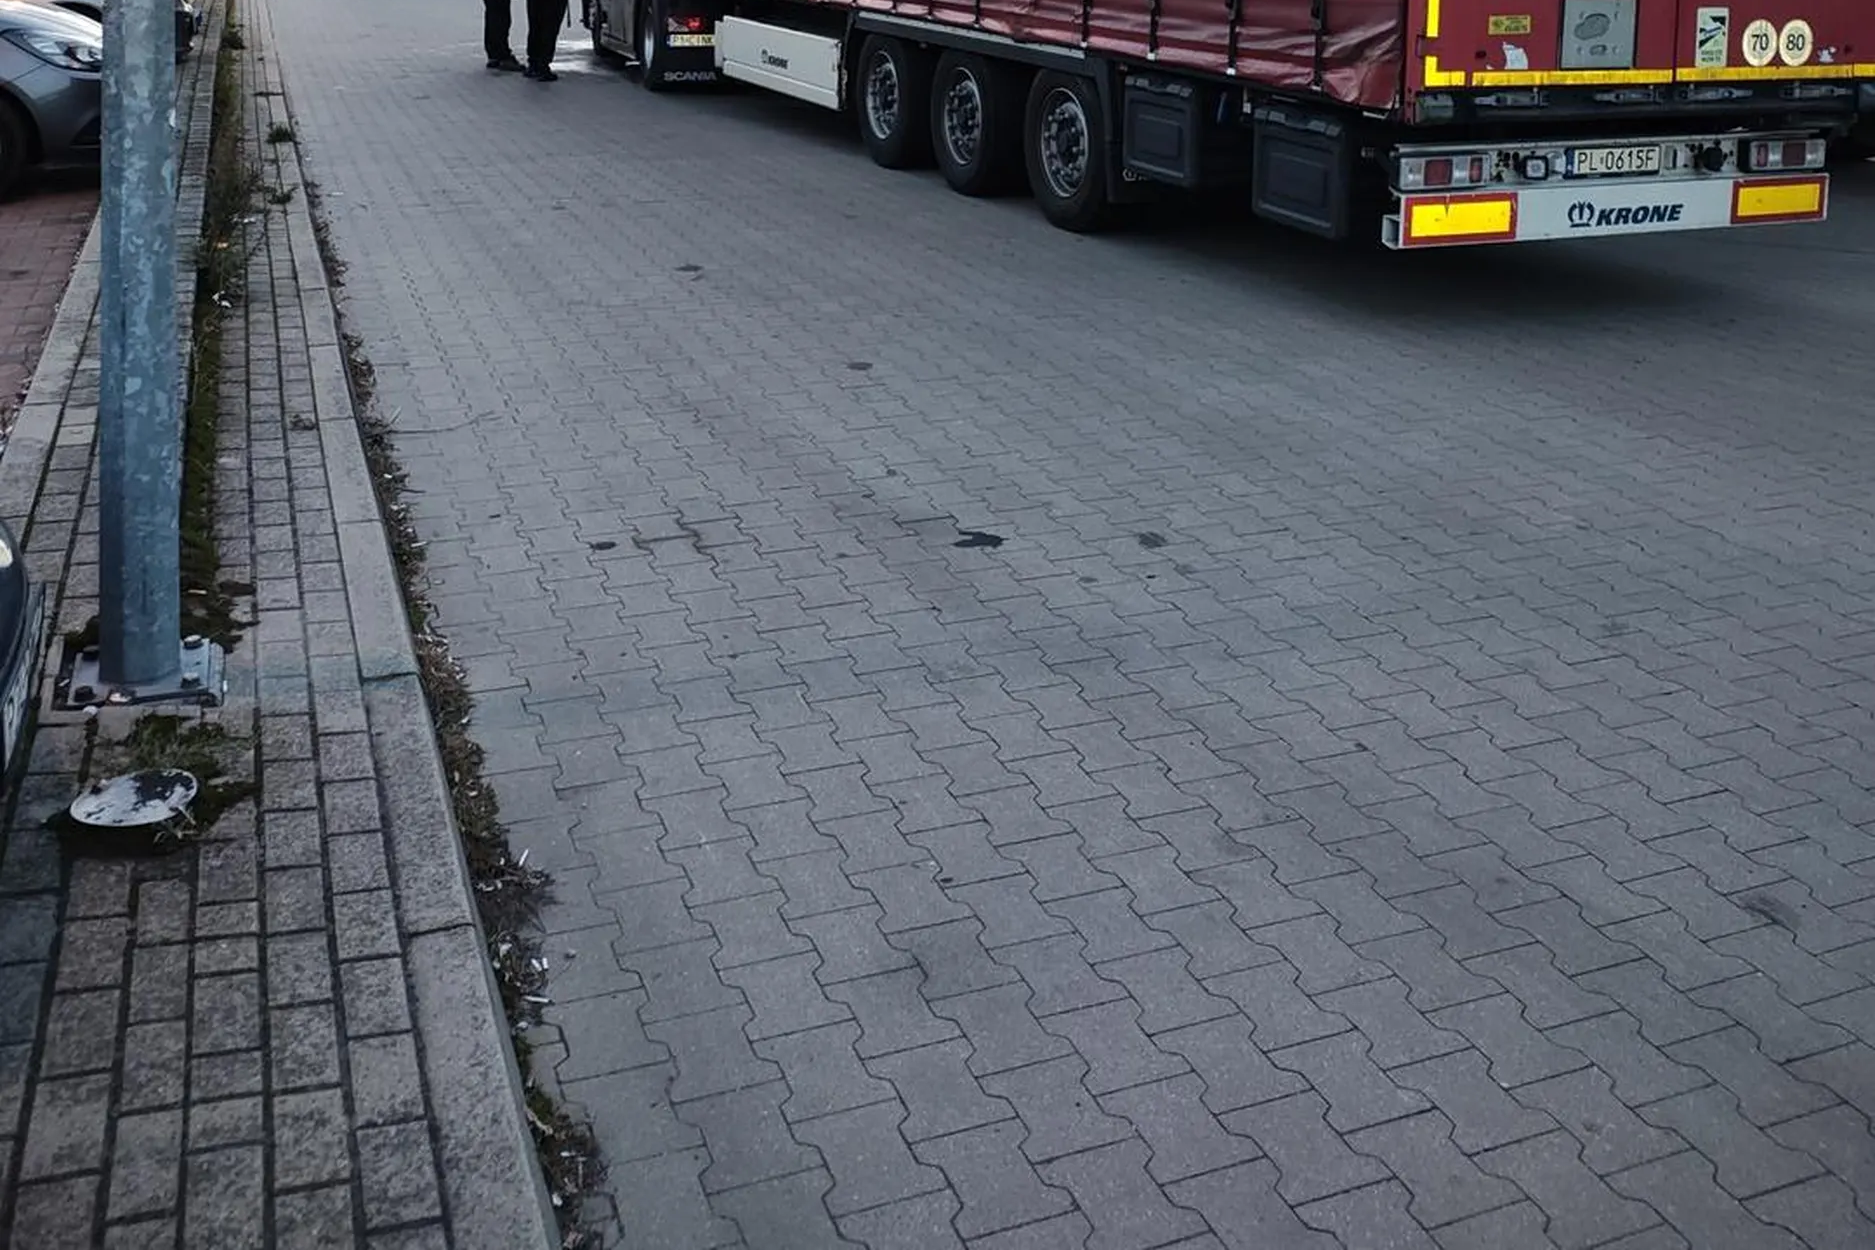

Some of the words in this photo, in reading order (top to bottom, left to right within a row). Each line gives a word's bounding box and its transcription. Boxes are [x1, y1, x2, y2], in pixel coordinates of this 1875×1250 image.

[1751, 33, 1770, 51] 70
[1786, 33, 1806, 51] 80
[663, 70, 717, 82] SCANIA
[1578, 151, 1597, 172] PL
[1605, 148, 1657, 170] 0615F
[1595, 203, 1684, 227] KRONE
